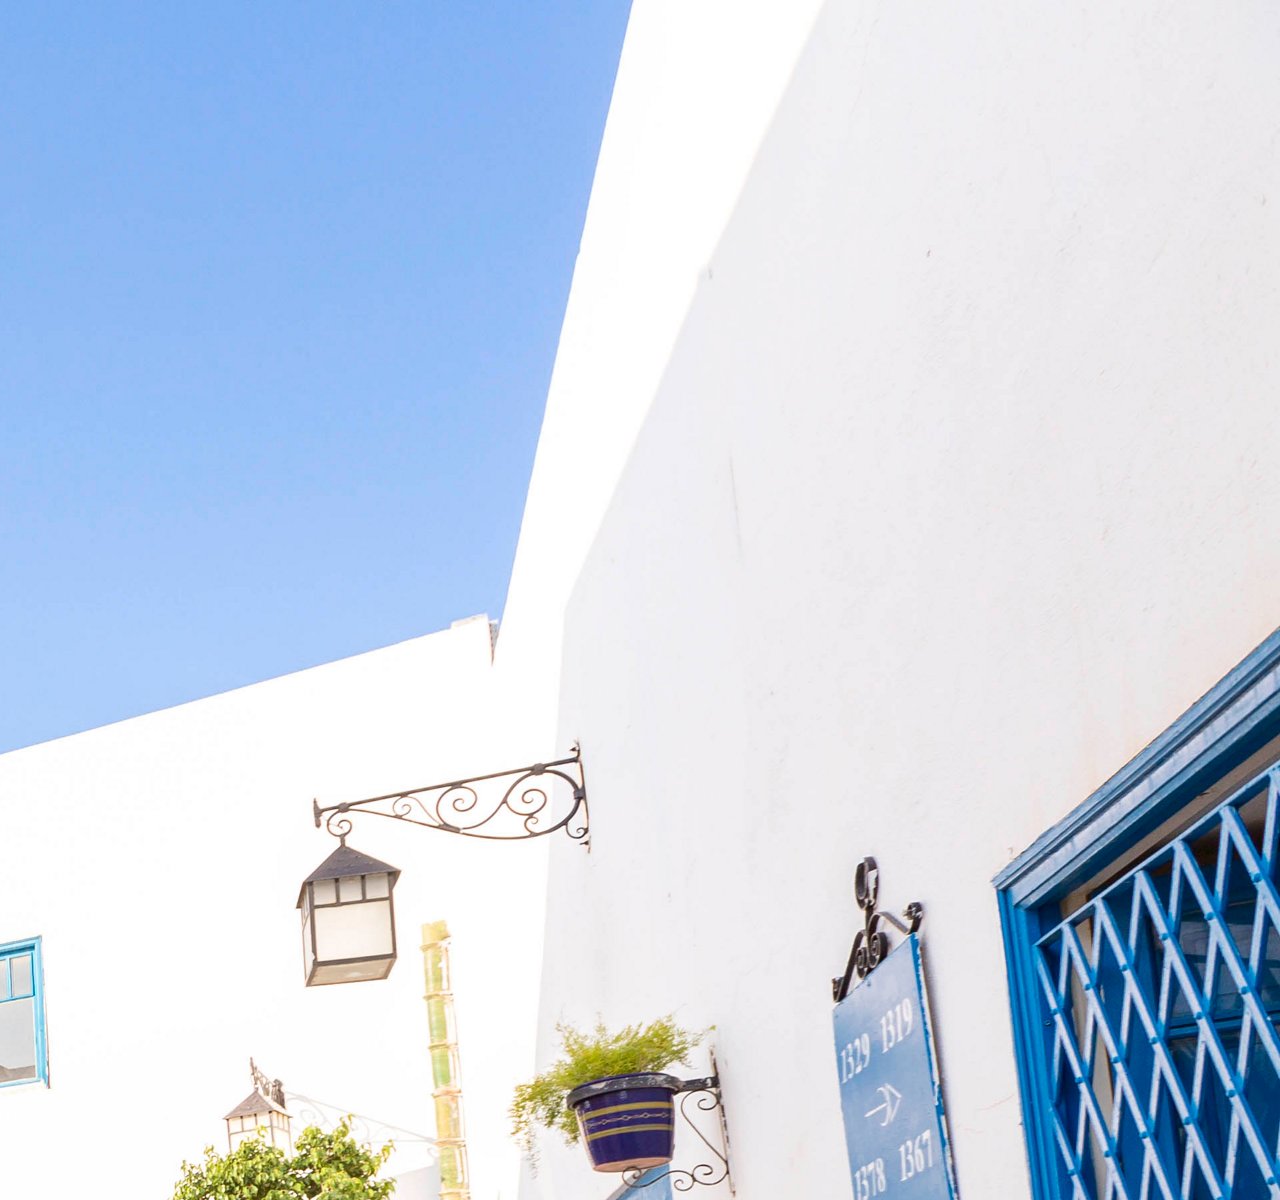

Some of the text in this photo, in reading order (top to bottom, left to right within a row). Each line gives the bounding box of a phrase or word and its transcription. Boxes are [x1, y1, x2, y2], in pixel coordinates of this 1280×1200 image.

[840, 998, 913, 1084] 1329 1319
[899, 1129, 933, 1182] 1367
